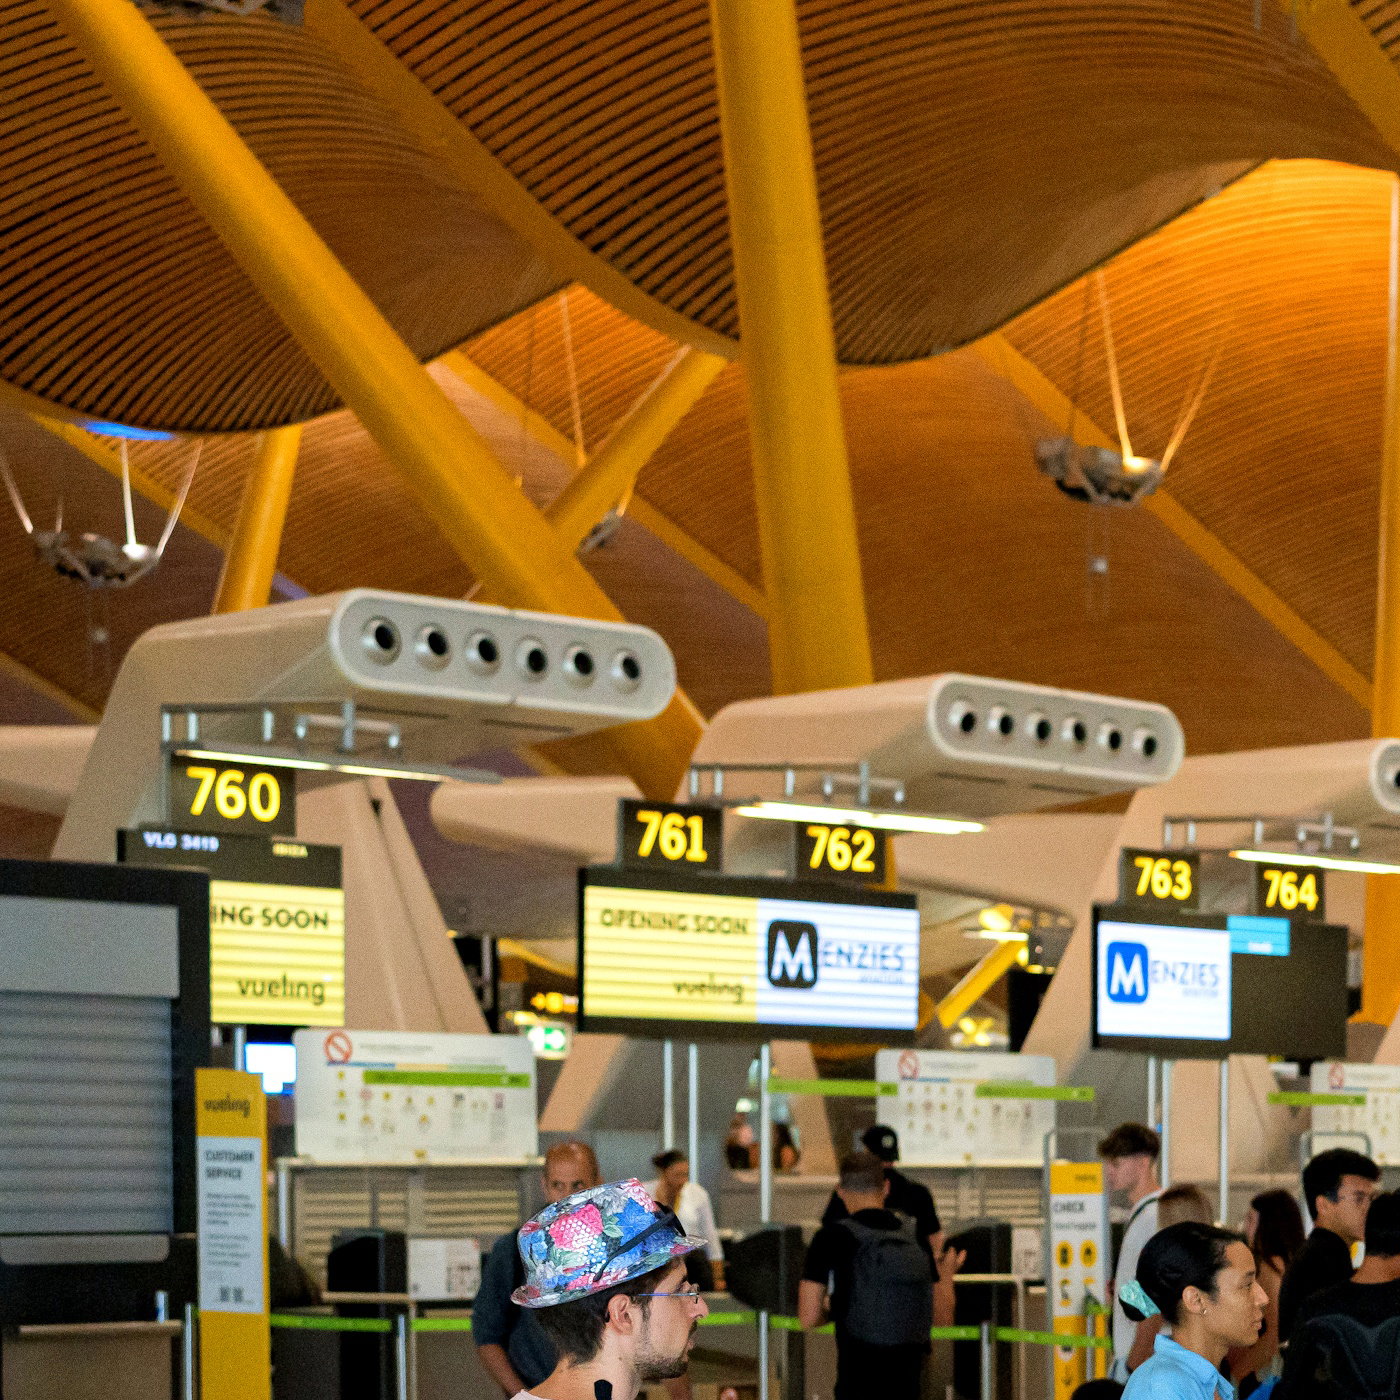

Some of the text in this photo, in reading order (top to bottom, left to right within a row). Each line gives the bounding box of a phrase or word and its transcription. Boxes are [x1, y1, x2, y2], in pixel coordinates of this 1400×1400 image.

[186, 766, 281, 823] 760
[636, 809, 708, 863] 761
[806, 824, 876, 873] 762
[1134, 856, 1193, 900] 763
[1263, 869, 1319, 911] 764
[261, 908, 329, 930] SOON
[600, 908, 750, 935] OPENING SOON
[768, 926, 904, 983] MENZIES
[1108, 949, 1220, 998] MENZIES
[237, 972, 326, 1006] vueling
[672, 973, 745, 1005] vueling
[204, 1094, 251, 1118] vueling
[205, 1150, 255, 1163] CUSTOMER
[205, 1166, 242, 1180] SERVICE
